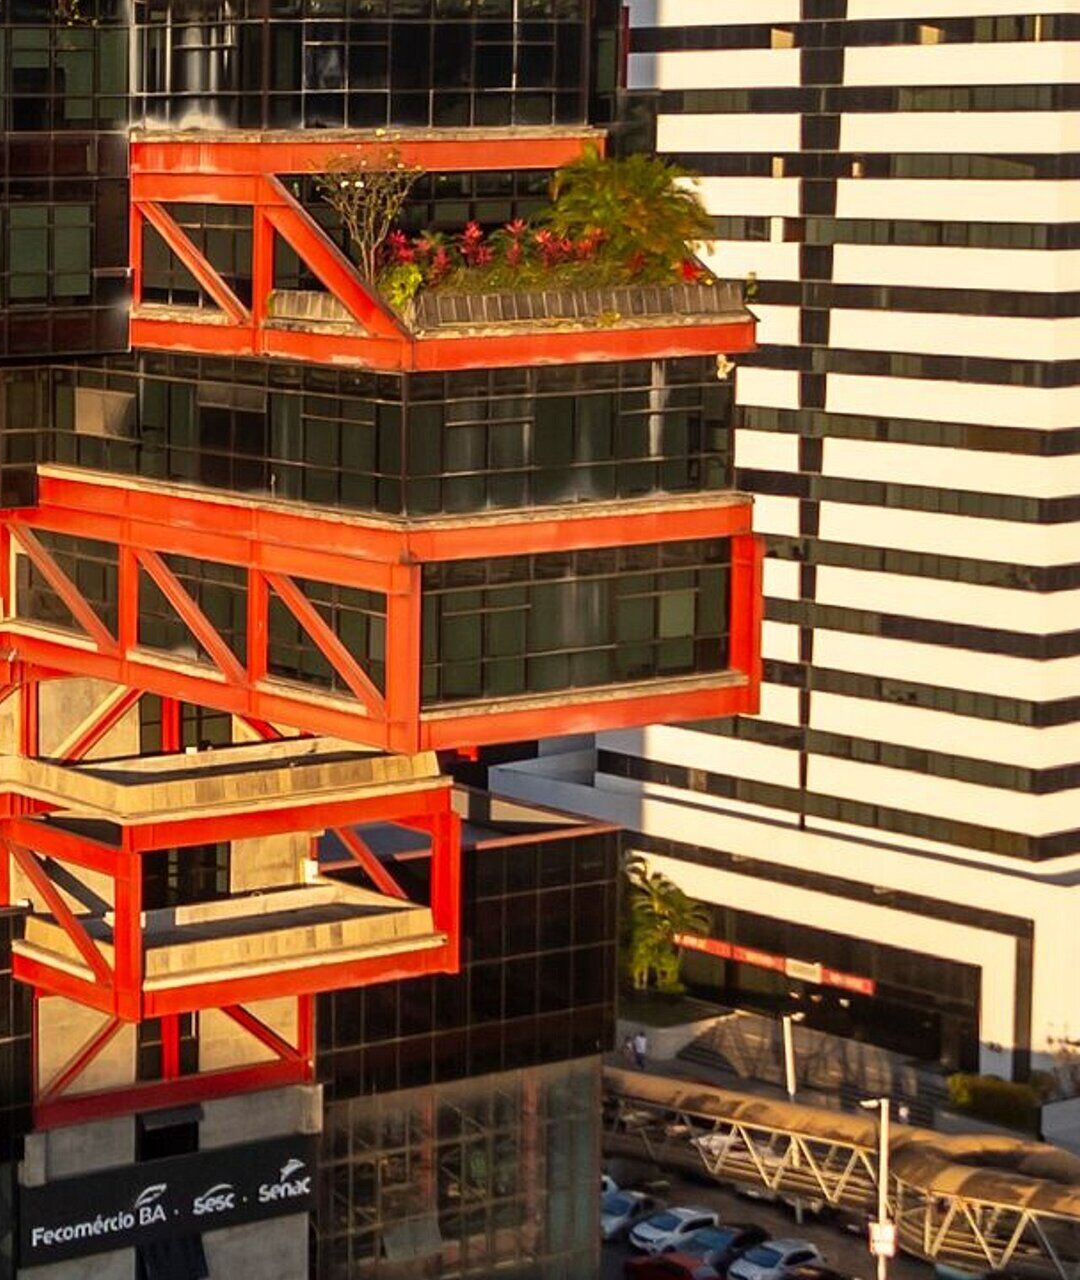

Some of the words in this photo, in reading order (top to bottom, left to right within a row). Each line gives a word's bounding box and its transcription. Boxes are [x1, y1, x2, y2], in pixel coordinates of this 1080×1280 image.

[31, 1211, 134, 1247] Fecomércio
[139, 1206, 167, 1226] BA
[192, 1192, 236, 1215] Sesc
[258, 1175, 312, 1203] Senac
